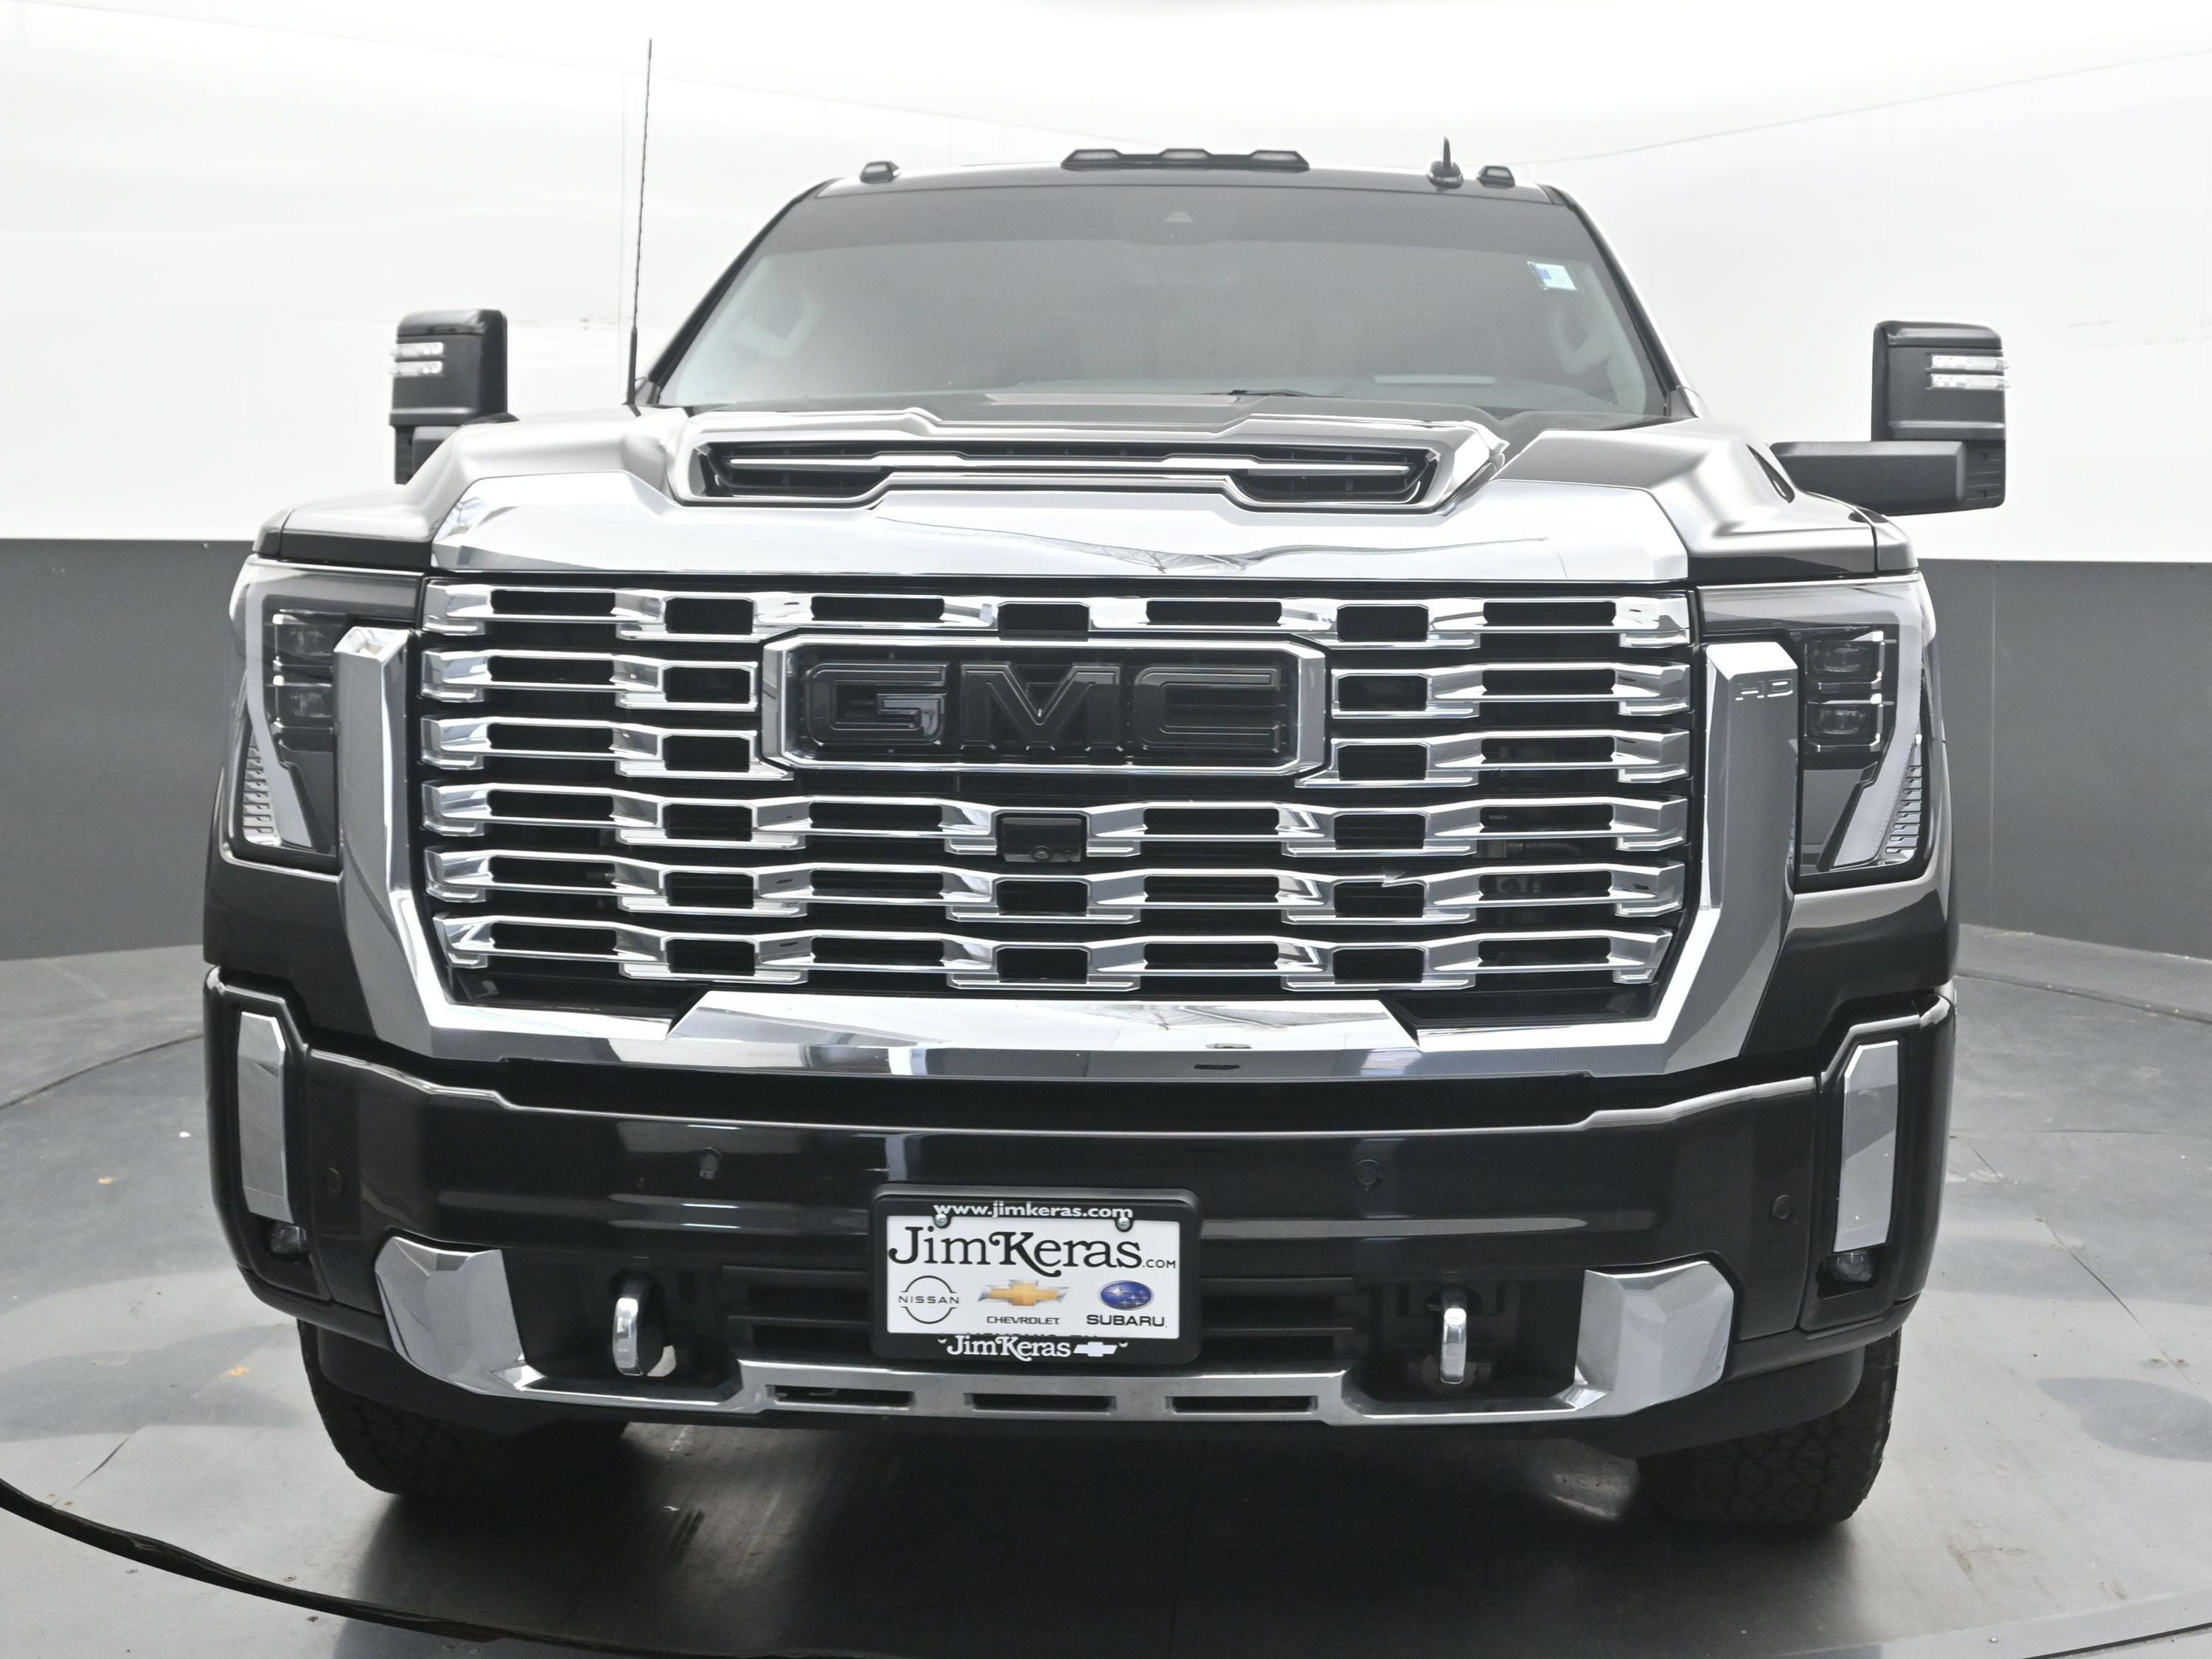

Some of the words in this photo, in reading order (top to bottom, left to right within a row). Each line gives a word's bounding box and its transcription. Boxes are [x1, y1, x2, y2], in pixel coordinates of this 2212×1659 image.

[806, 661, 1281, 752] GMC
[933, 1201, 1133, 1218] www.jimkeras.com
[898, 1295, 959, 1304] NISSAN
[987, 1316, 1060, 1325] CHEVROLET
[1086, 1315, 1165, 1327] SUBARU
[947, 1335, 1071, 1361] JimKeras
